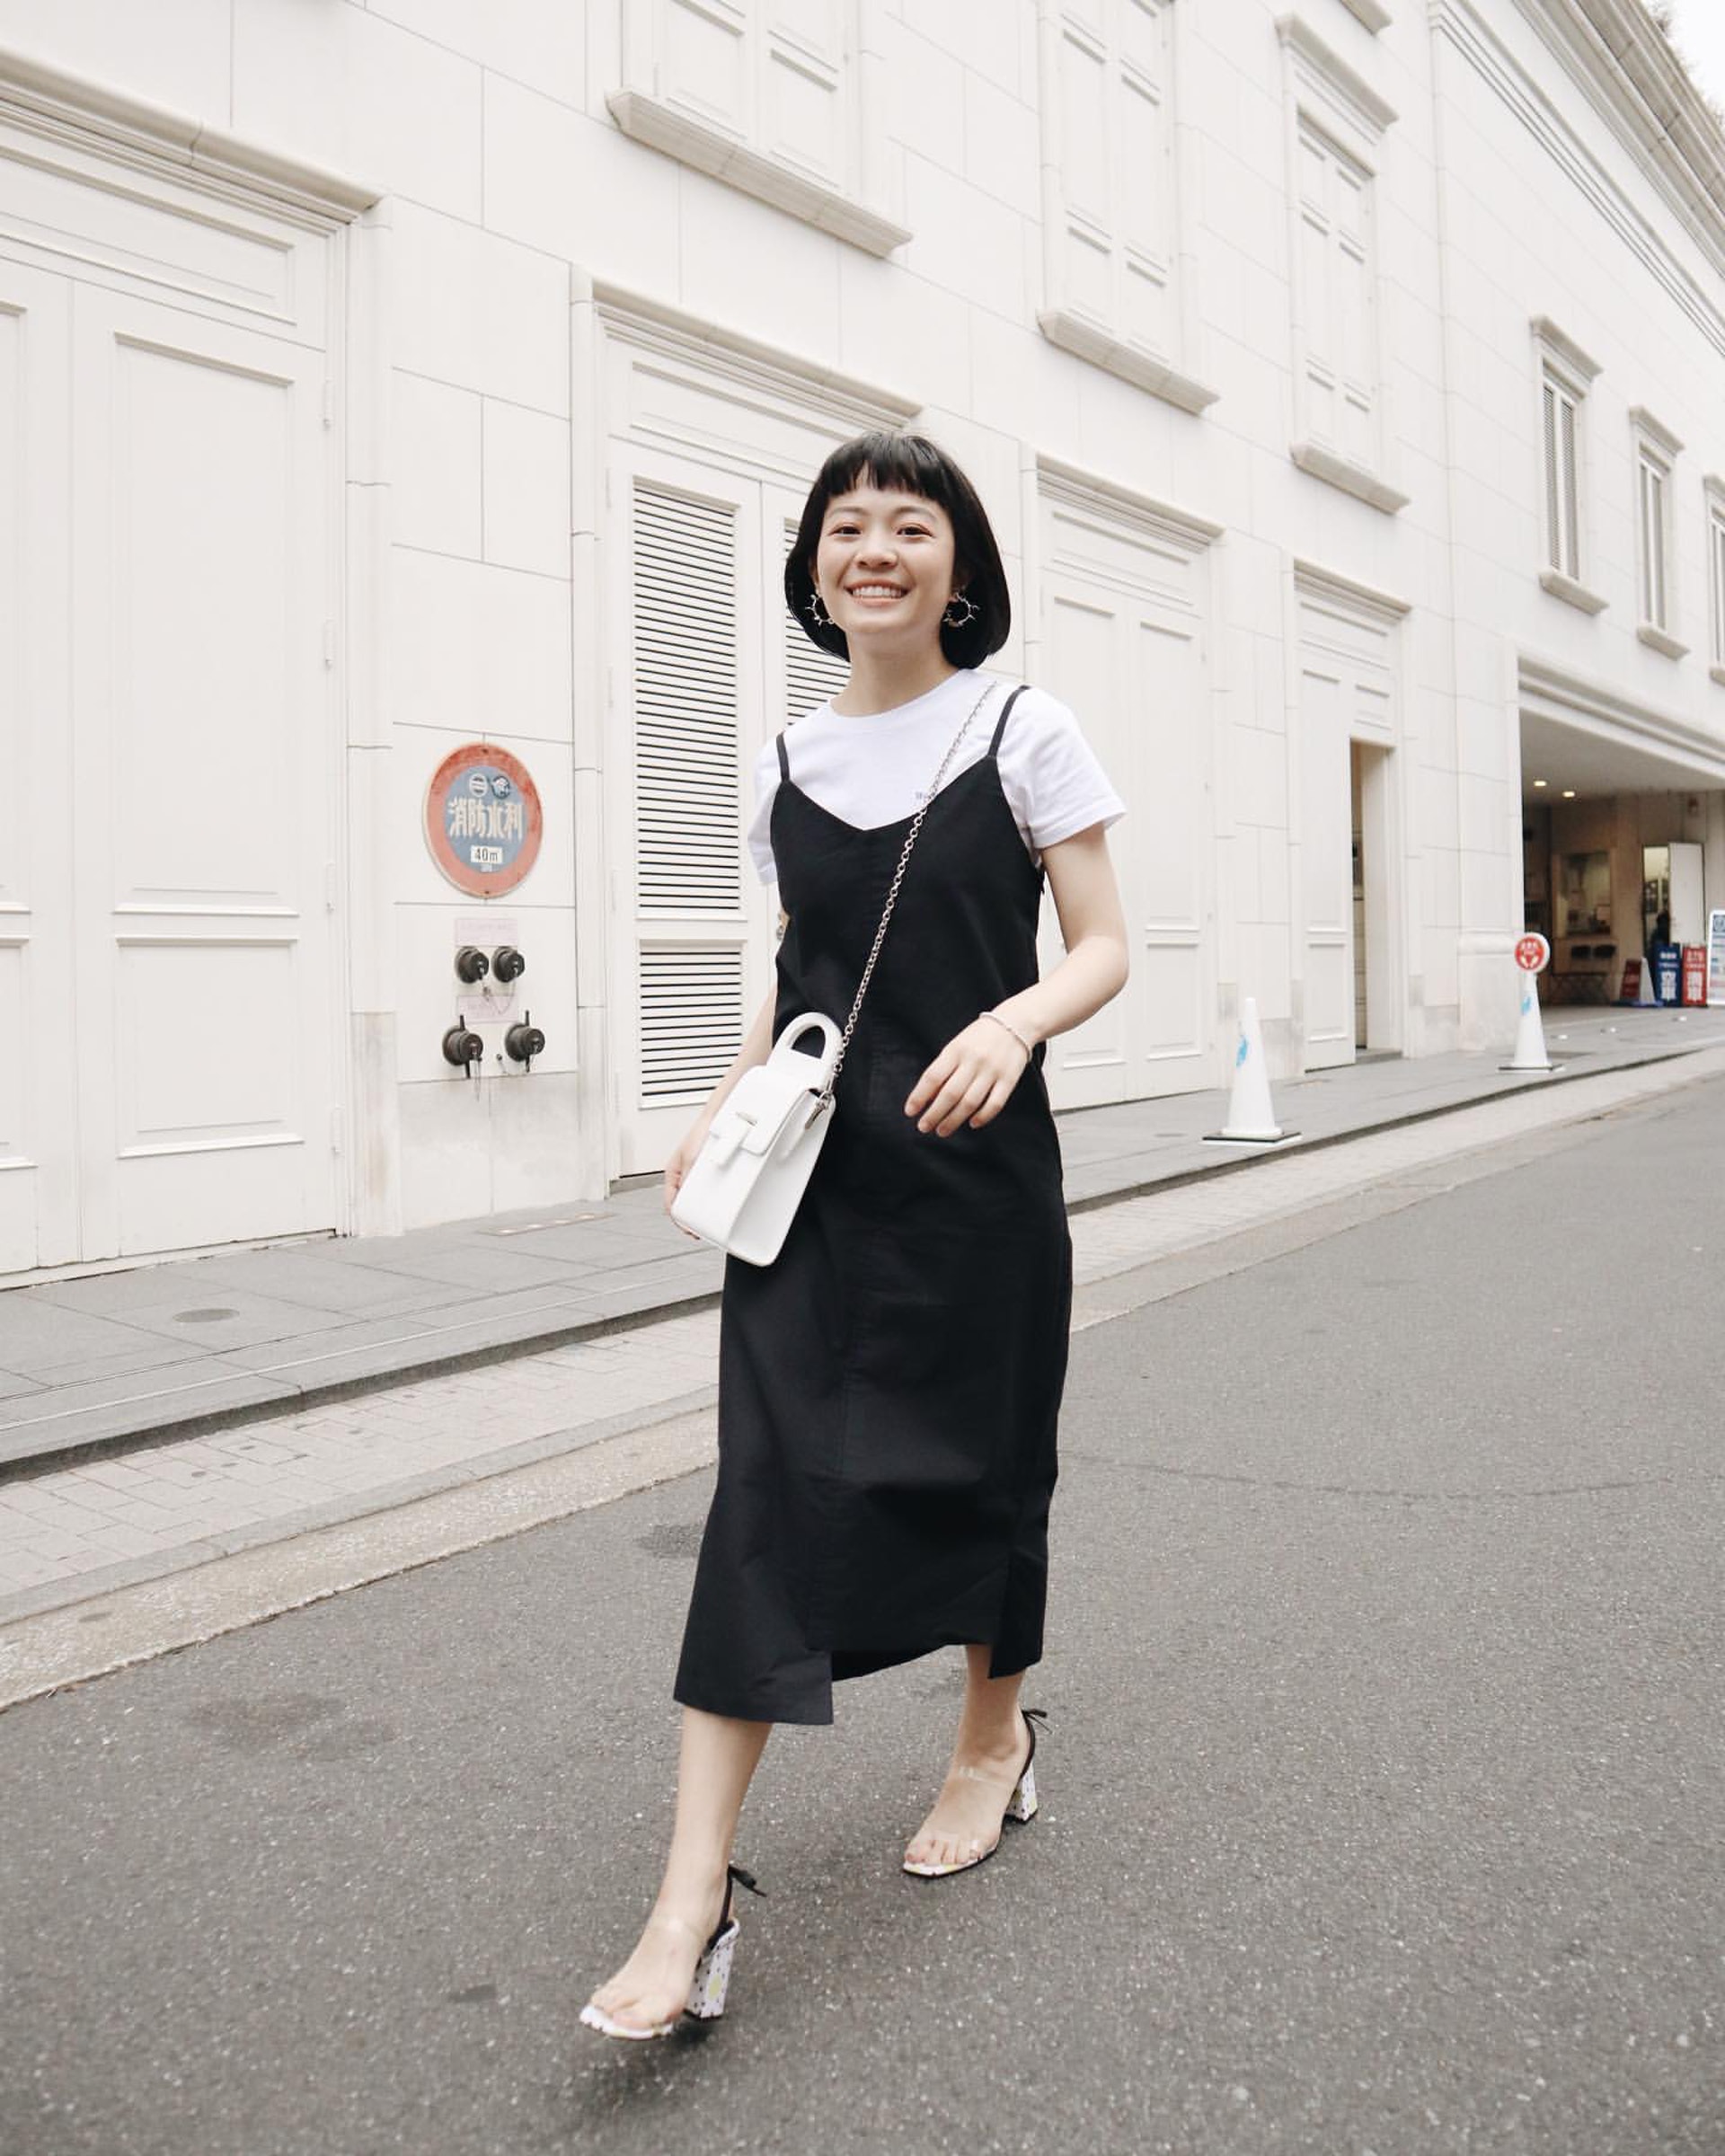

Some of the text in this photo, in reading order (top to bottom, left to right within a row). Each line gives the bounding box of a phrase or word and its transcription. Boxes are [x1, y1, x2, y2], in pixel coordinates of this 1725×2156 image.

[447, 798, 523, 841] 消防水利
[474, 847, 499, 862] 40m
